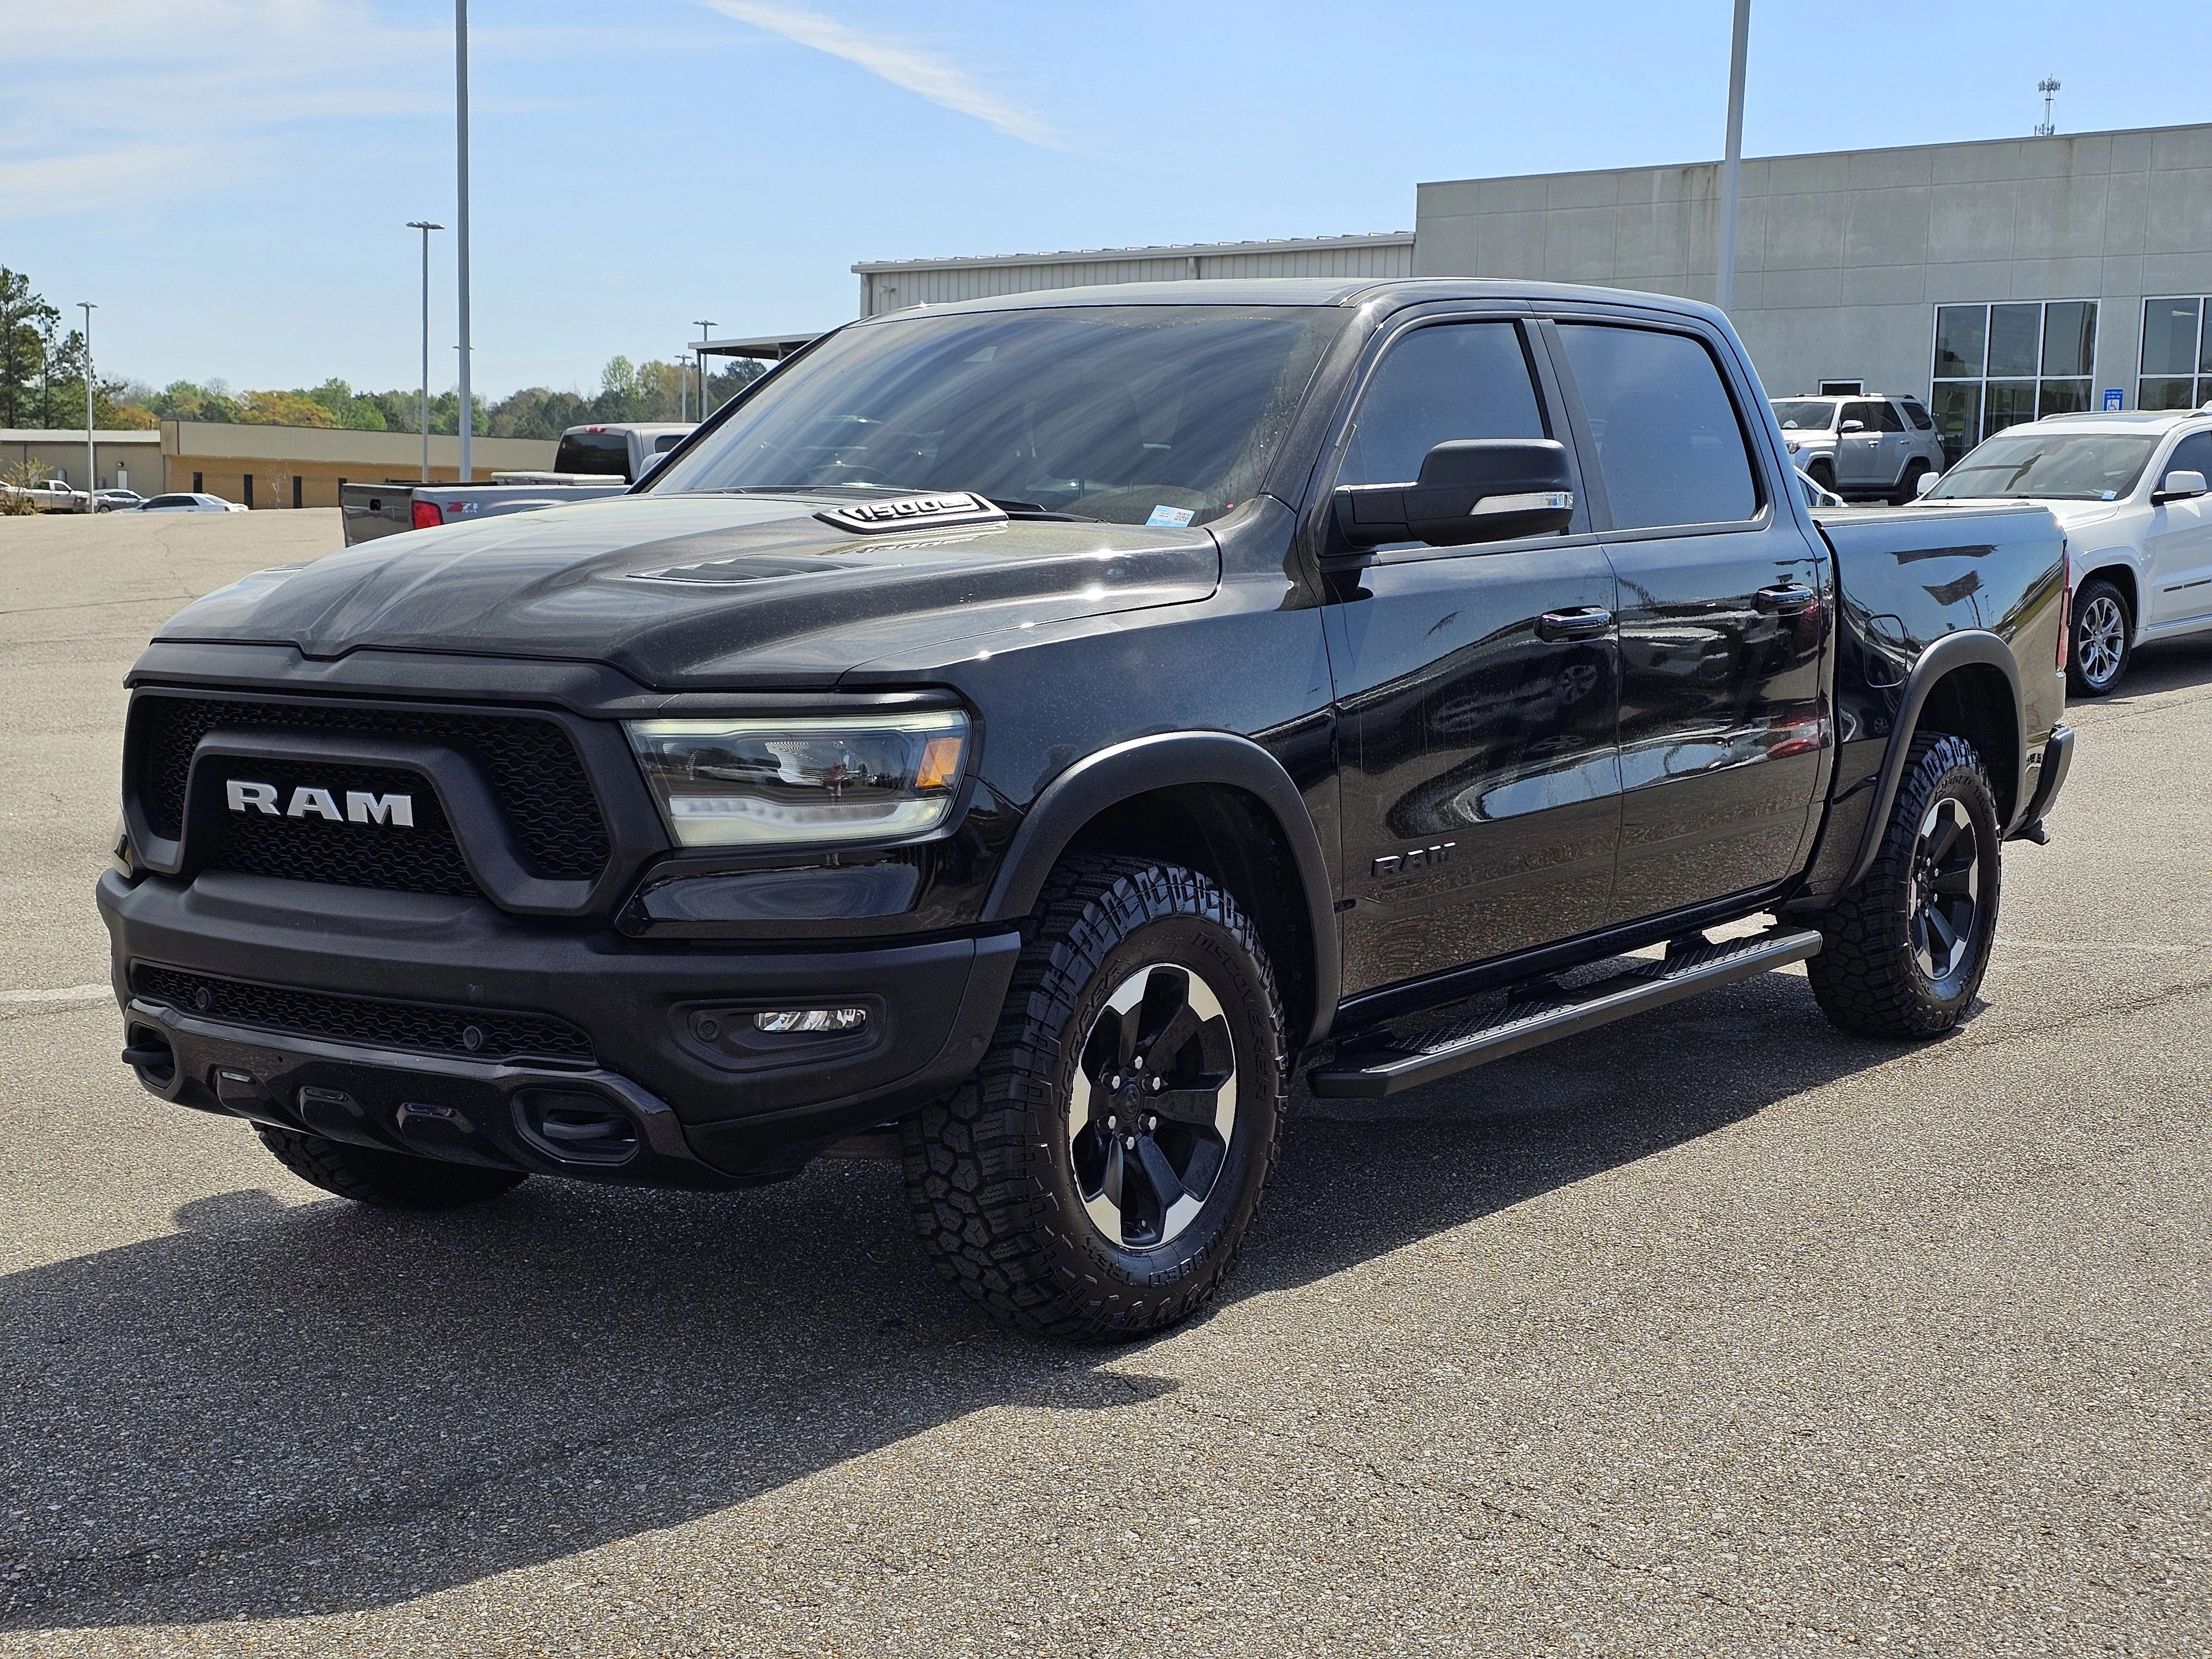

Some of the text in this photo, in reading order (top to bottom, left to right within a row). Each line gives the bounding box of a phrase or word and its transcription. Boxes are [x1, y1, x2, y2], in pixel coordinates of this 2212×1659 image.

[855, 499, 940, 520] 1500
[227, 779, 414, 828] RAM
[1371, 842, 1456, 877] RAM
[1191, 931, 1269, 1100] DISCOVERER
